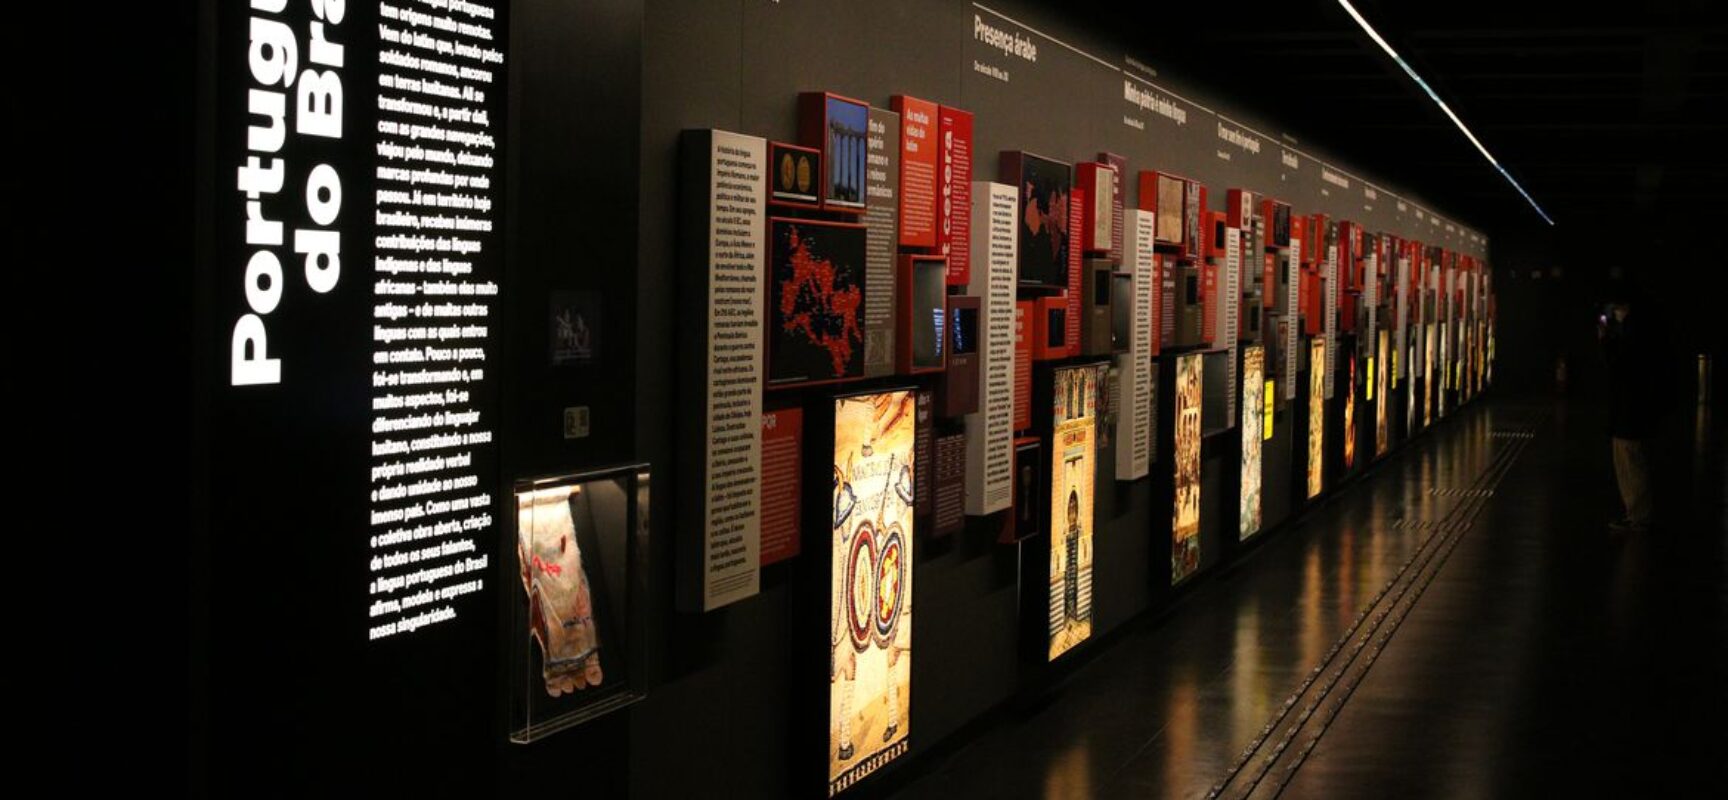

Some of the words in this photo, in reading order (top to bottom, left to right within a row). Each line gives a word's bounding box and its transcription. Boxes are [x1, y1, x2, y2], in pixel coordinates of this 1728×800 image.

[380, 2, 398, 19] tem
[399, 8, 432, 27] origens
[433, 16, 457, 32] muito
[379, 23, 399, 42] Vem
[400, 29, 413, 45] do
[413, 31, 435, 50] latim
[455, 40, 482, 59] levado
[482, 48, 503, 64] pelos
[974, 14, 1013, 56] Presença
[1014, 32, 1037, 62] árabe
[379, 49, 420, 69] soldados
[460, 66, 492, 82] ancorou
[379, 74, 394, 88] em
[395, 74, 422, 92] terras
[462, 86, 473, 101] Ali
[474, 90, 484, 103] se
[378, 94, 432, 116] transformou
[442, 107, 448, 119] a
[448, 108, 472, 122] partir
[378, 120, 398, 134] com
[398, 123, 410, 135] as
[410, 124, 445, 141] grandes
[377, 140, 404, 160] viajou
[405, 145, 425, 161] pelo
[457, 150, 493, 168] deixando
[377, 166, 410, 181] marcas
[411, 168, 454, 185] profundas
[454, 175, 469, 189] por
[469, 175, 489, 188] onde
[231, 0, 298, 387] Portug
[422, 194, 436, 206] em
[474, 195, 491, 212] hoje
[294, 163, 342, 294] do
[420, 214, 455, 229] recebeu
[435, 236, 451, 251] das
[419, 260, 426, 272] e
[426, 258, 442, 273] das
[375, 279, 416, 295] africanas
[458, 281, 475, 295] elas
[475, 281, 497, 295] muito
[374, 302, 408, 321] antigas
[415, 305, 422, 317] e
[422, 302, 433, 317] de
[433, 302, 462, 317] muitas
[462, 303, 488, 316] outras
[407, 327, 426, 339] com
[427, 327, 438, 339] as
[438, 324, 461, 342] quais
[461, 325, 487, 338] entrou
[373, 351, 389, 364] em
[426, 346, 452, 361] Pouco
[452, 349, 458, 360] a
[373, 371, 399, 387] foi-se
[400, 367, 462, 385] transformando
[470, 369, 483, 380] em
[373, 393, 404, 410] muitos
[446, 389, 469, 403] foi-se
[372, 413, 432, 433] diferenciando
[433, 412, 444, 426] do
[445, 409, 480, 427] linguajar
[410, 432, 462, 451] constituindo
[463, 434, 468, 445] a
[469, 431, 491, 444] nossa
[406, 456, 445, 474] realidade
[445, 452, 470, 468] verbal
[371, 490, 378, 502] e
[379, 483, 407, 501] dando
[408, 478, 442, 496] unidade
[442, 479, 453, 491] ao
[454, 475, 478, 489] nosso
[371, 508, 404, 525] imenso
[426, 500, 451, 515] Como
[451, 498, 469, 511] uma
[469, 493, 490, 507] vasta
[370, 536, 377, 548] e
[378, 528, 412, 547] coletiva
[413, 525, 433, 540] obra
[370, 556, 383, 571] de
[383, 551, 408, 568] todos
[410, 550, 420, 563] os
[421, 546, 441, 560] seus
[370, 582, 376, 594] a
[406, 564, 453, 588] portuguesa
[454, 560, 465, 574] do
[466, 554, 487, 572] Brasil
[402, 588, 433, 609] modela
[435, 590, 440, 601] e
[441, 580, 476, 600] expressa
[478, 579, 482, 590] a
[370, 622, 396, 640] nossa
